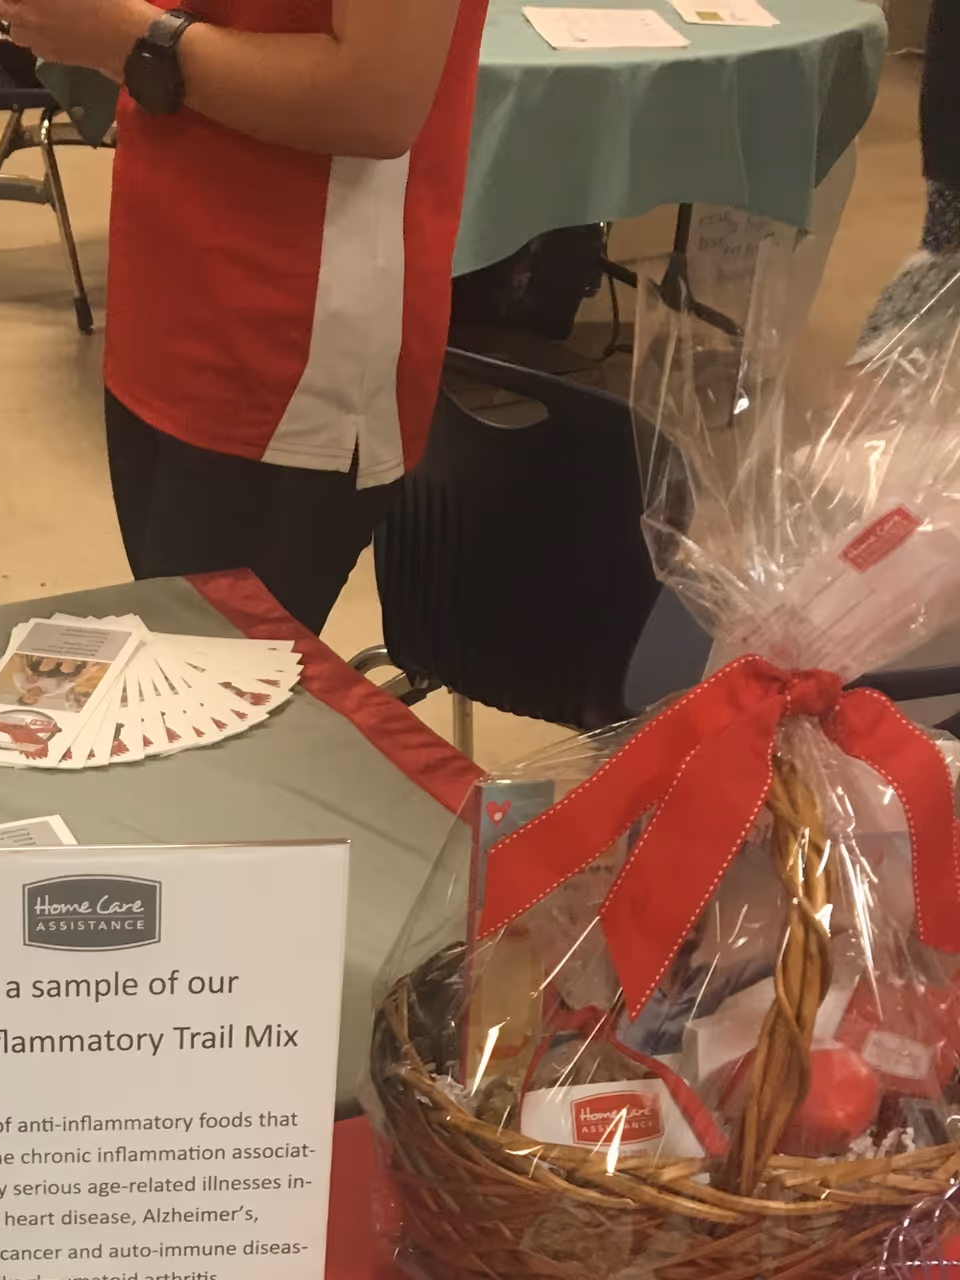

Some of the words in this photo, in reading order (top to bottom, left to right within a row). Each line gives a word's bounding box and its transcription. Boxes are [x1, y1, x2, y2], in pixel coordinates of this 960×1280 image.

[33, 895, 92, 917] Home
[96, 894, 145, 915] Care
[35, 919, 146, 932] ASSISTANCE
[6, 981, 20, 999] a
[32, 971, 138, 1003] sample
[149, 970, 179, 995] of
[188, 976, 239, 994] our
[173, 1024, 233, 1050] Trail
[245, 1024, 298, 1048] Mix
[18, 1115, 193, 1132] anti-inflammatory
[199, 1112, 252, 1128] foods
[259, 1111, 298, 1127] that
[580, 1106, 617, 1120] Home
[21, 1148, 91, 1164] chronic
[98, 1145, 225, 1163] inflammation
[232, 1143, 315, 1159] associat-
[14, 1180, 81, 1196] serious
[88, 1176, 195, 1197] age-related
[203, 1176, 281, 1191] illnesses
[288, 1174, 312, 1188] in-
[5, 1211, 55, 1226] heart
[61, 1210, 136, 1226] disease,
[142, 1205, 258, 1223] Alzheimer’s,
[0, 1249, 62, 1261] cancer
[68, 1244, 102, 1259] and
[109, 1242, 236, 1258] auto-immune
[243, 1240, 308, 1255] diseas-
